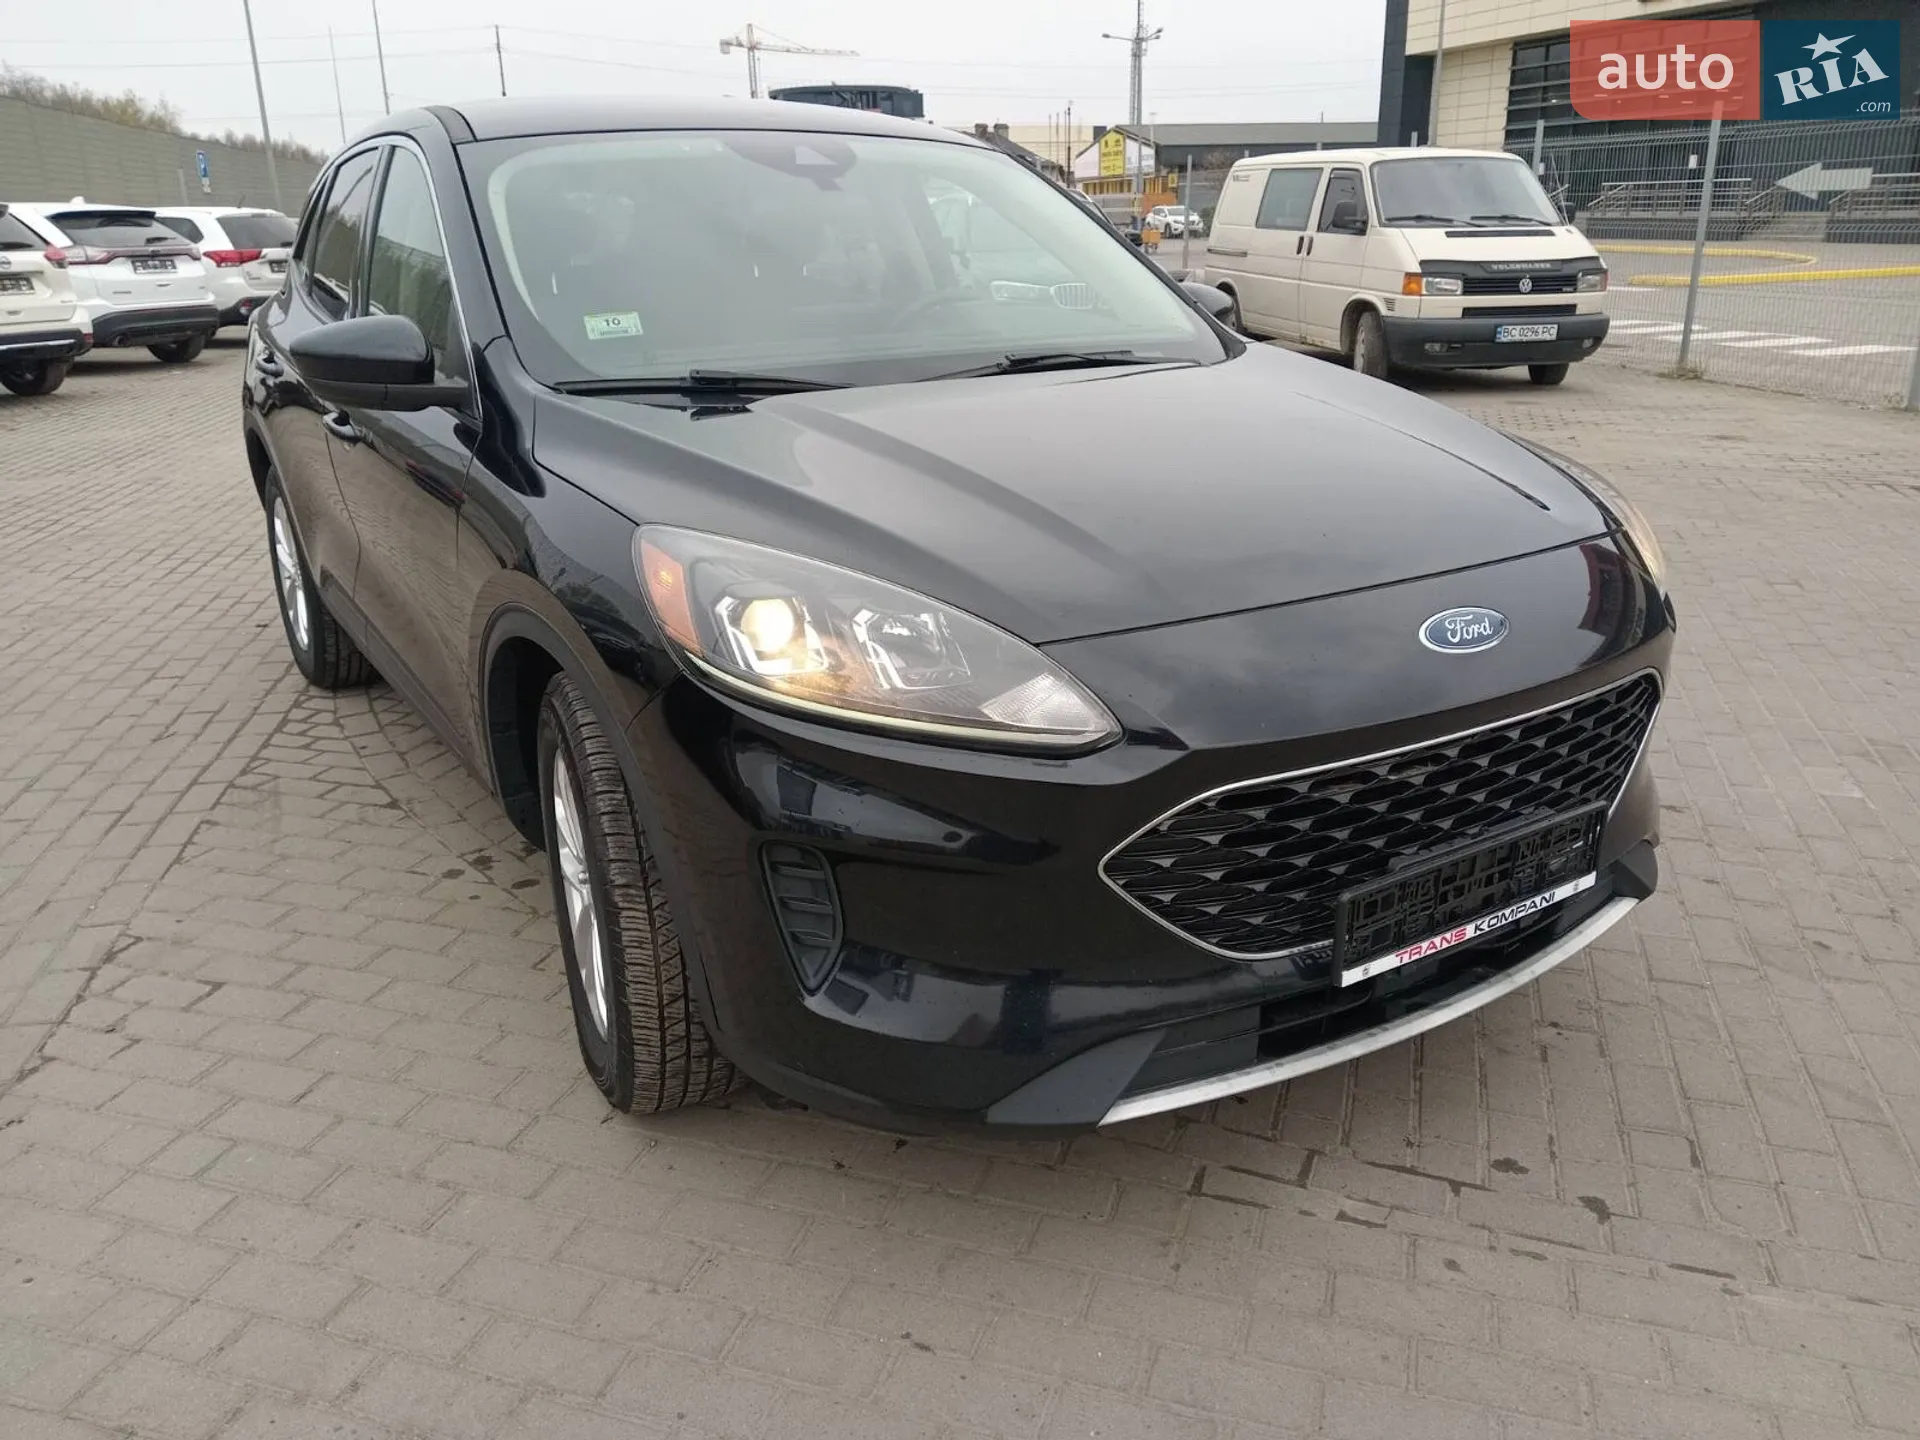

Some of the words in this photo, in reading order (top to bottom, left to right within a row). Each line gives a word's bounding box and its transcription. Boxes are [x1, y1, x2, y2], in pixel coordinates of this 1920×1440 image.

[1503, 327, 1517, 338] BC
[1519, 326, 1540, 337] 0296
[1541, 326, 1555, 336] PC
[1445, 614, 1493, 643] Ford
[1395, 927, 1467, 964] TRANS
[1473, 891, 1556, 935] KOMPANI
